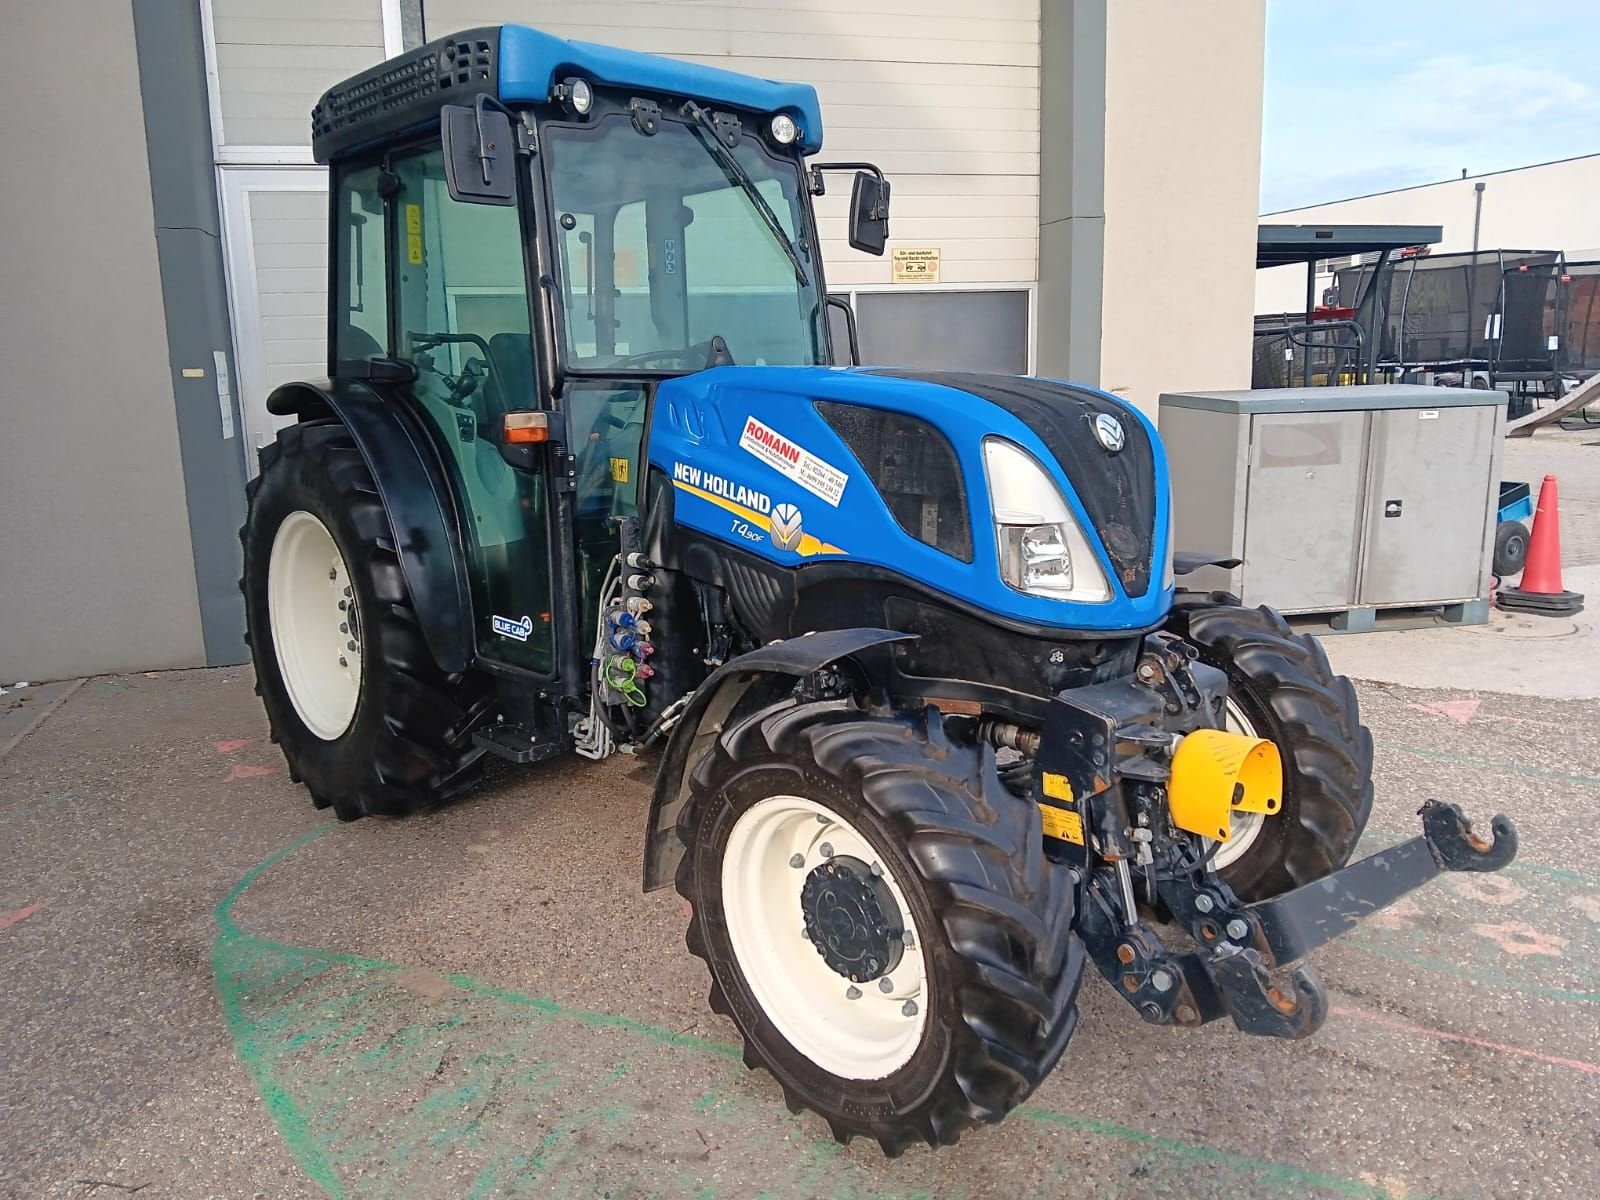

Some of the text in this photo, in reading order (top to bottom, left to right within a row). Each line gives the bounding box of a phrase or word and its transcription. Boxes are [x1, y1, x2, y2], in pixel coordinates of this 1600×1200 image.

[746, 421, 800, 464] ROMANN
[674, 462, 702, 487] NEW
[704, 472, 770, 514] HOLLAND
[495, 620, 510, 632] BLUE
[512, 626, 524, 636] CAB
